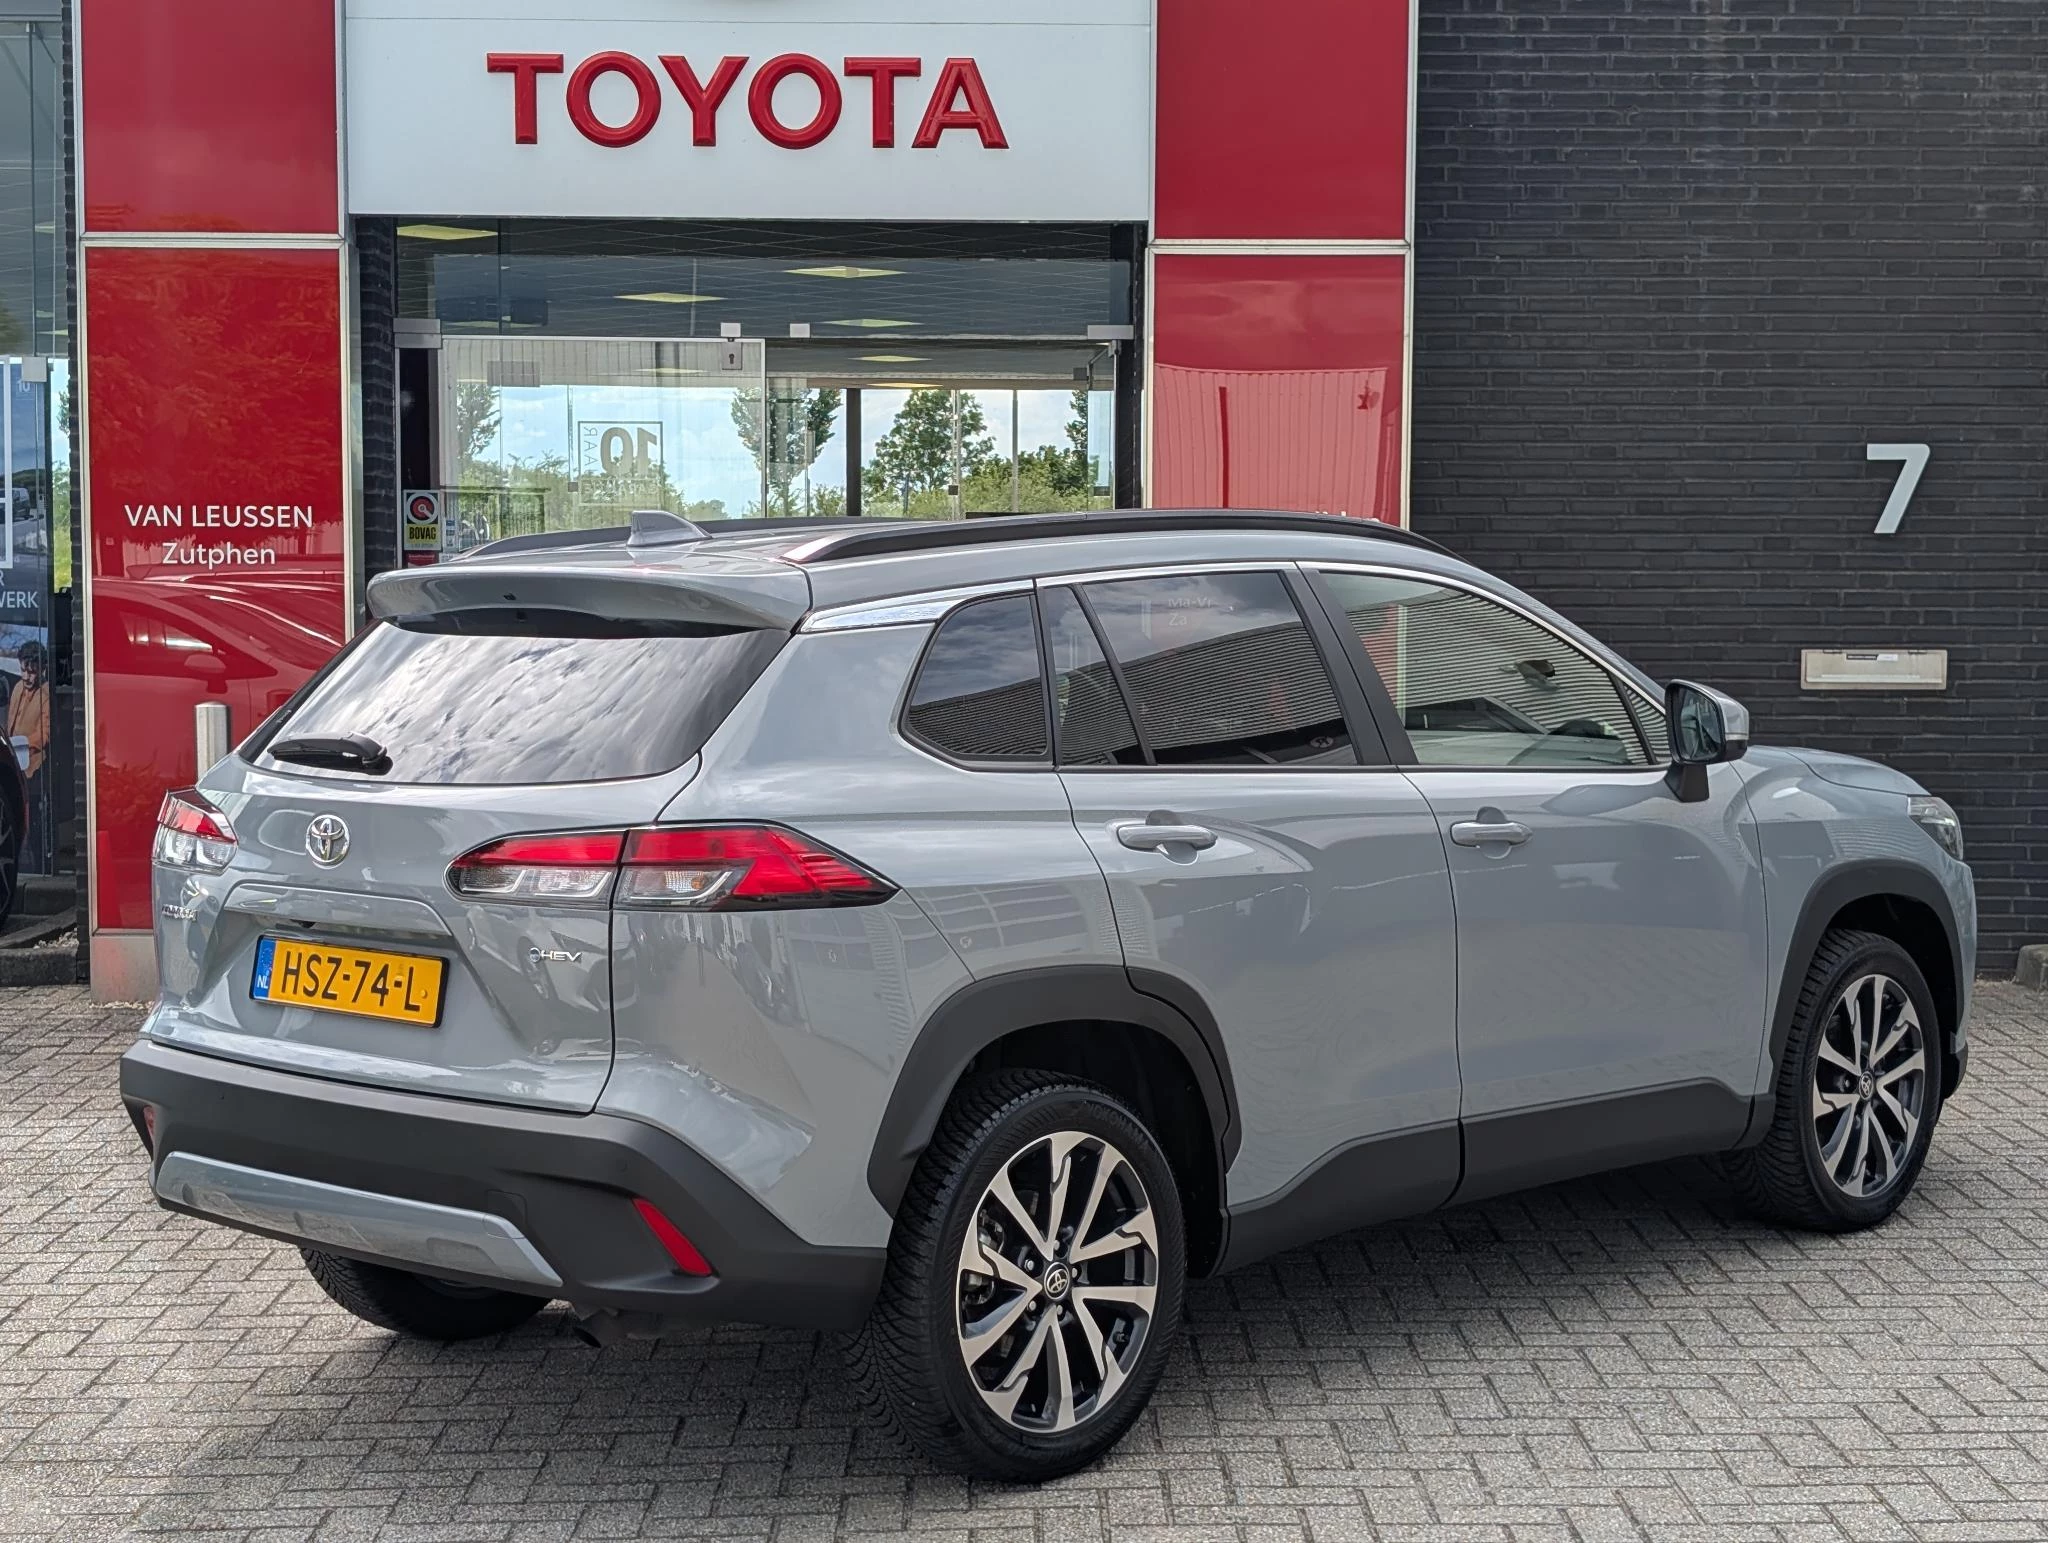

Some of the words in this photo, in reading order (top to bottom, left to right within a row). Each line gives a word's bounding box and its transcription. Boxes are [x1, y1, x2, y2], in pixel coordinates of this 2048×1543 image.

[486, 50, 1010, 150] TOYOTA
[1867, 443, 1931, 534] 7
[124, 504, 182, 527] VAN
[192, 504, 313, 528] LEUSSEN
[409, 526, 437, 540] BOVAG
[162, 541, 276, 570] Zutphen
[541, 950, 582, 961] HEV
[257, 977, 269, 989] NL
[281, 950, 421, 1012] HSZ-74-L
